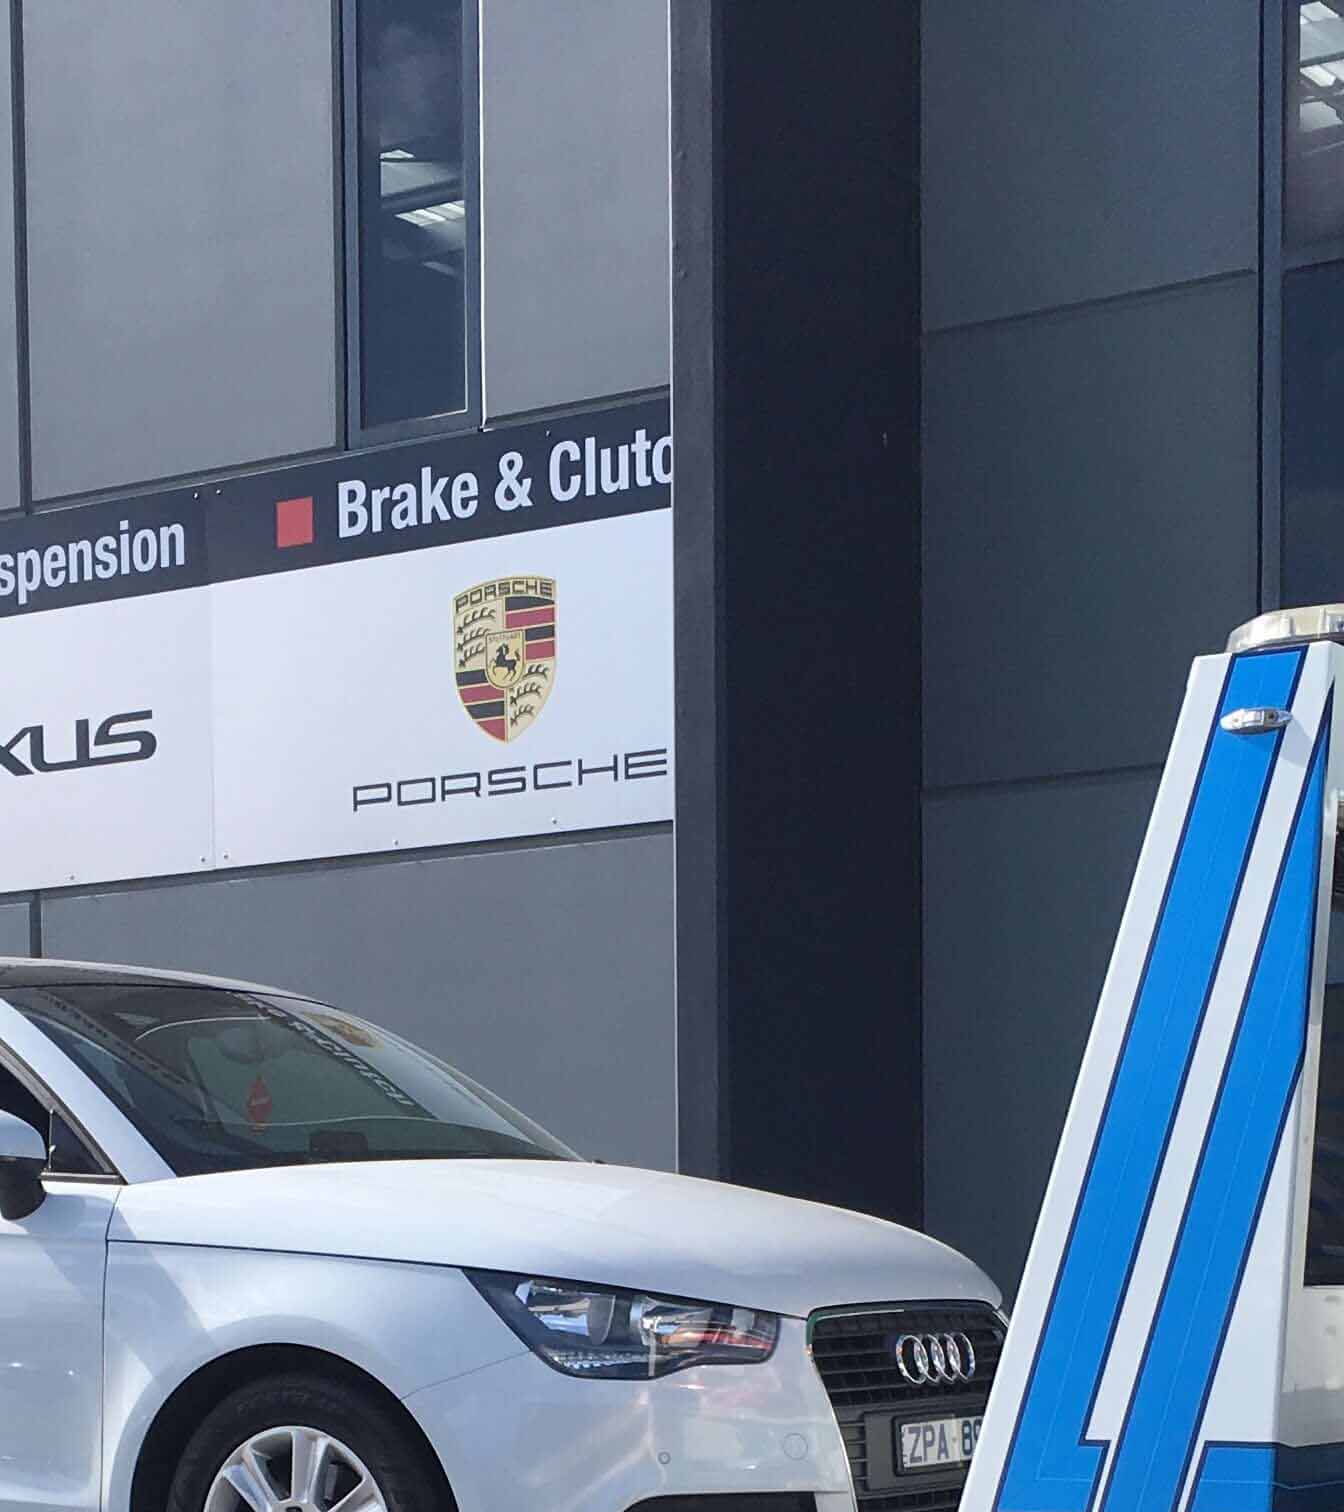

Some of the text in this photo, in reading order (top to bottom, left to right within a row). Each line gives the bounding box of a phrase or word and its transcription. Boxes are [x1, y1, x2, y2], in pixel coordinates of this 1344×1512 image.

[337, 467, 479, 538] Brake
[494, 451, 532, 512] &
[455, 579, 553, 613] PORSCHE
[353, 749, 669, 813] PORSCHE
[908, 1422, 950, 1464] ZPA
